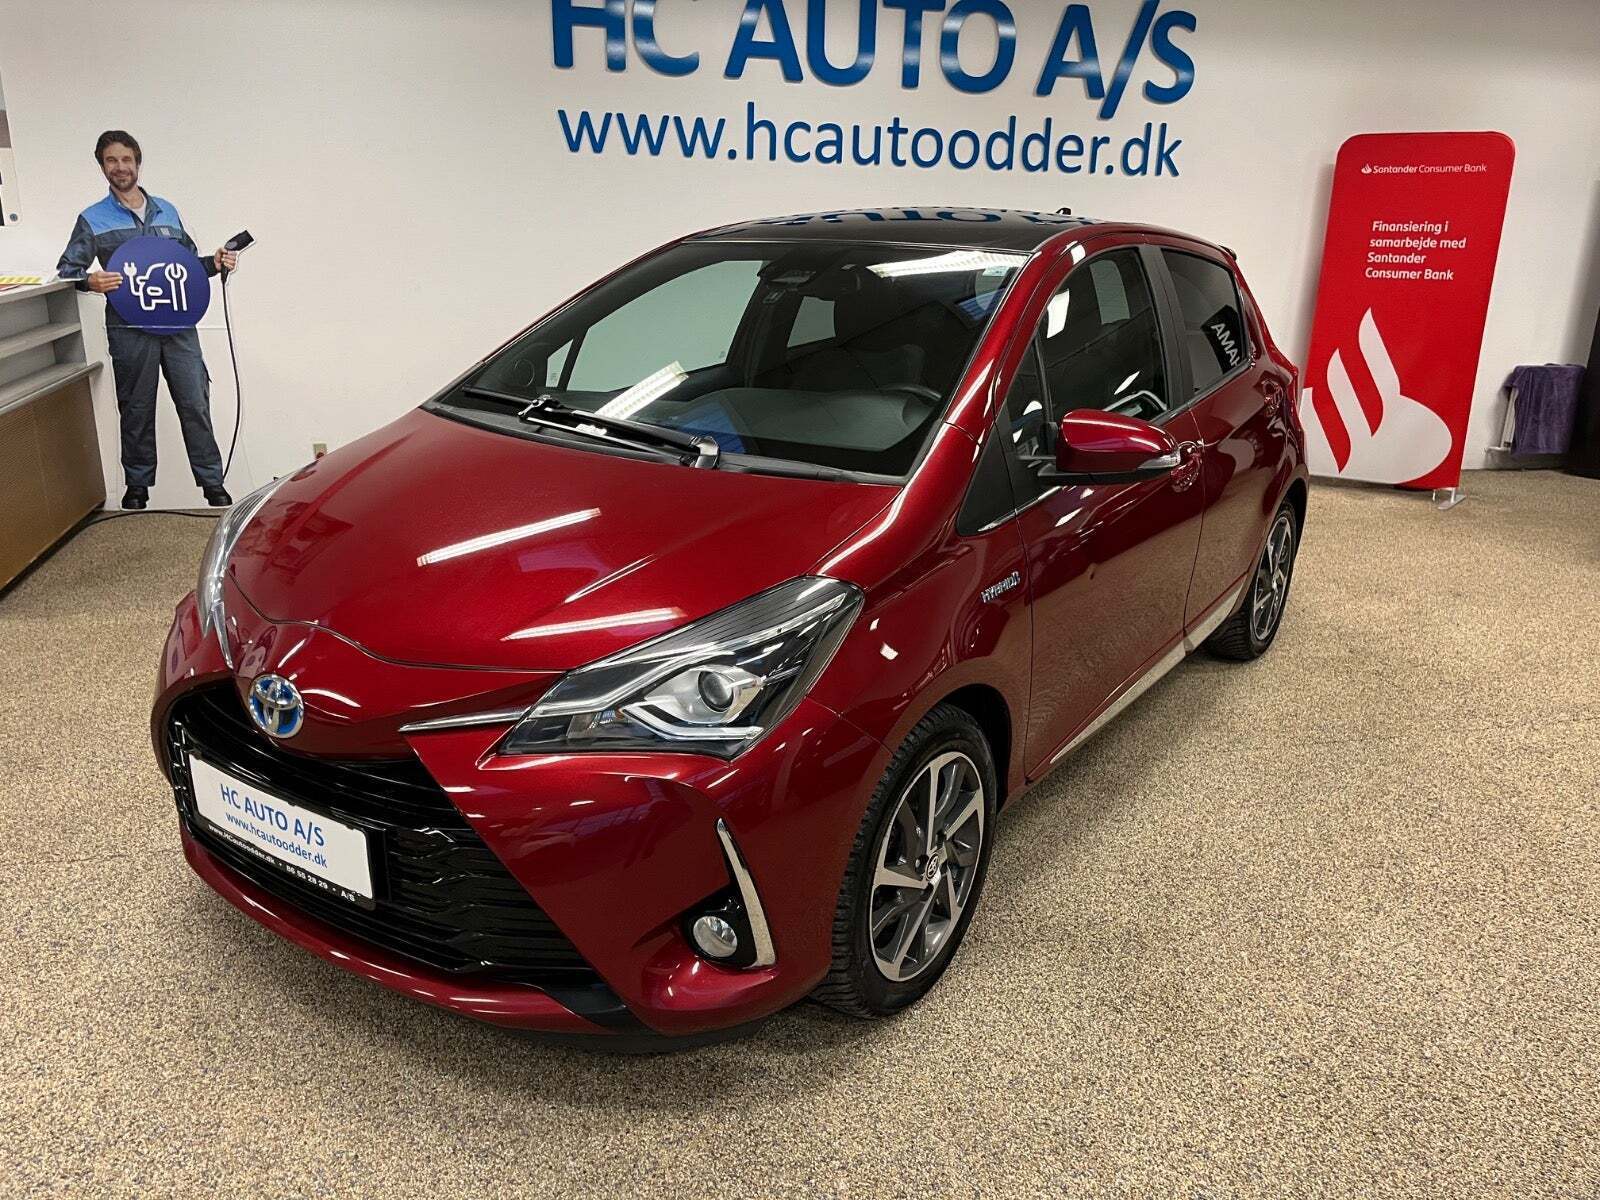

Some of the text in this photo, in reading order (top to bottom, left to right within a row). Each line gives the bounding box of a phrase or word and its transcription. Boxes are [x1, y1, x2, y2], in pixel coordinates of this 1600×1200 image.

[552, 0, 1196, 119] HC AUTO A/S
[557, 101, 1182, 177] www.hcautoodder.dk
[1372, 163, 1487, 174] Santander Consumer Bank
[1372, 221, 1442, 235] Finansiering
[1369, 236, 1467, 250] samarbejde med
[1367, 252, 1427, 264] Santander
[1365, 267, 1454, 280] Consumer Bank
[220, 783, 325, 847] HC AUTO A/S
[225, 812, 328, 869] www.hcautoodder.dk
